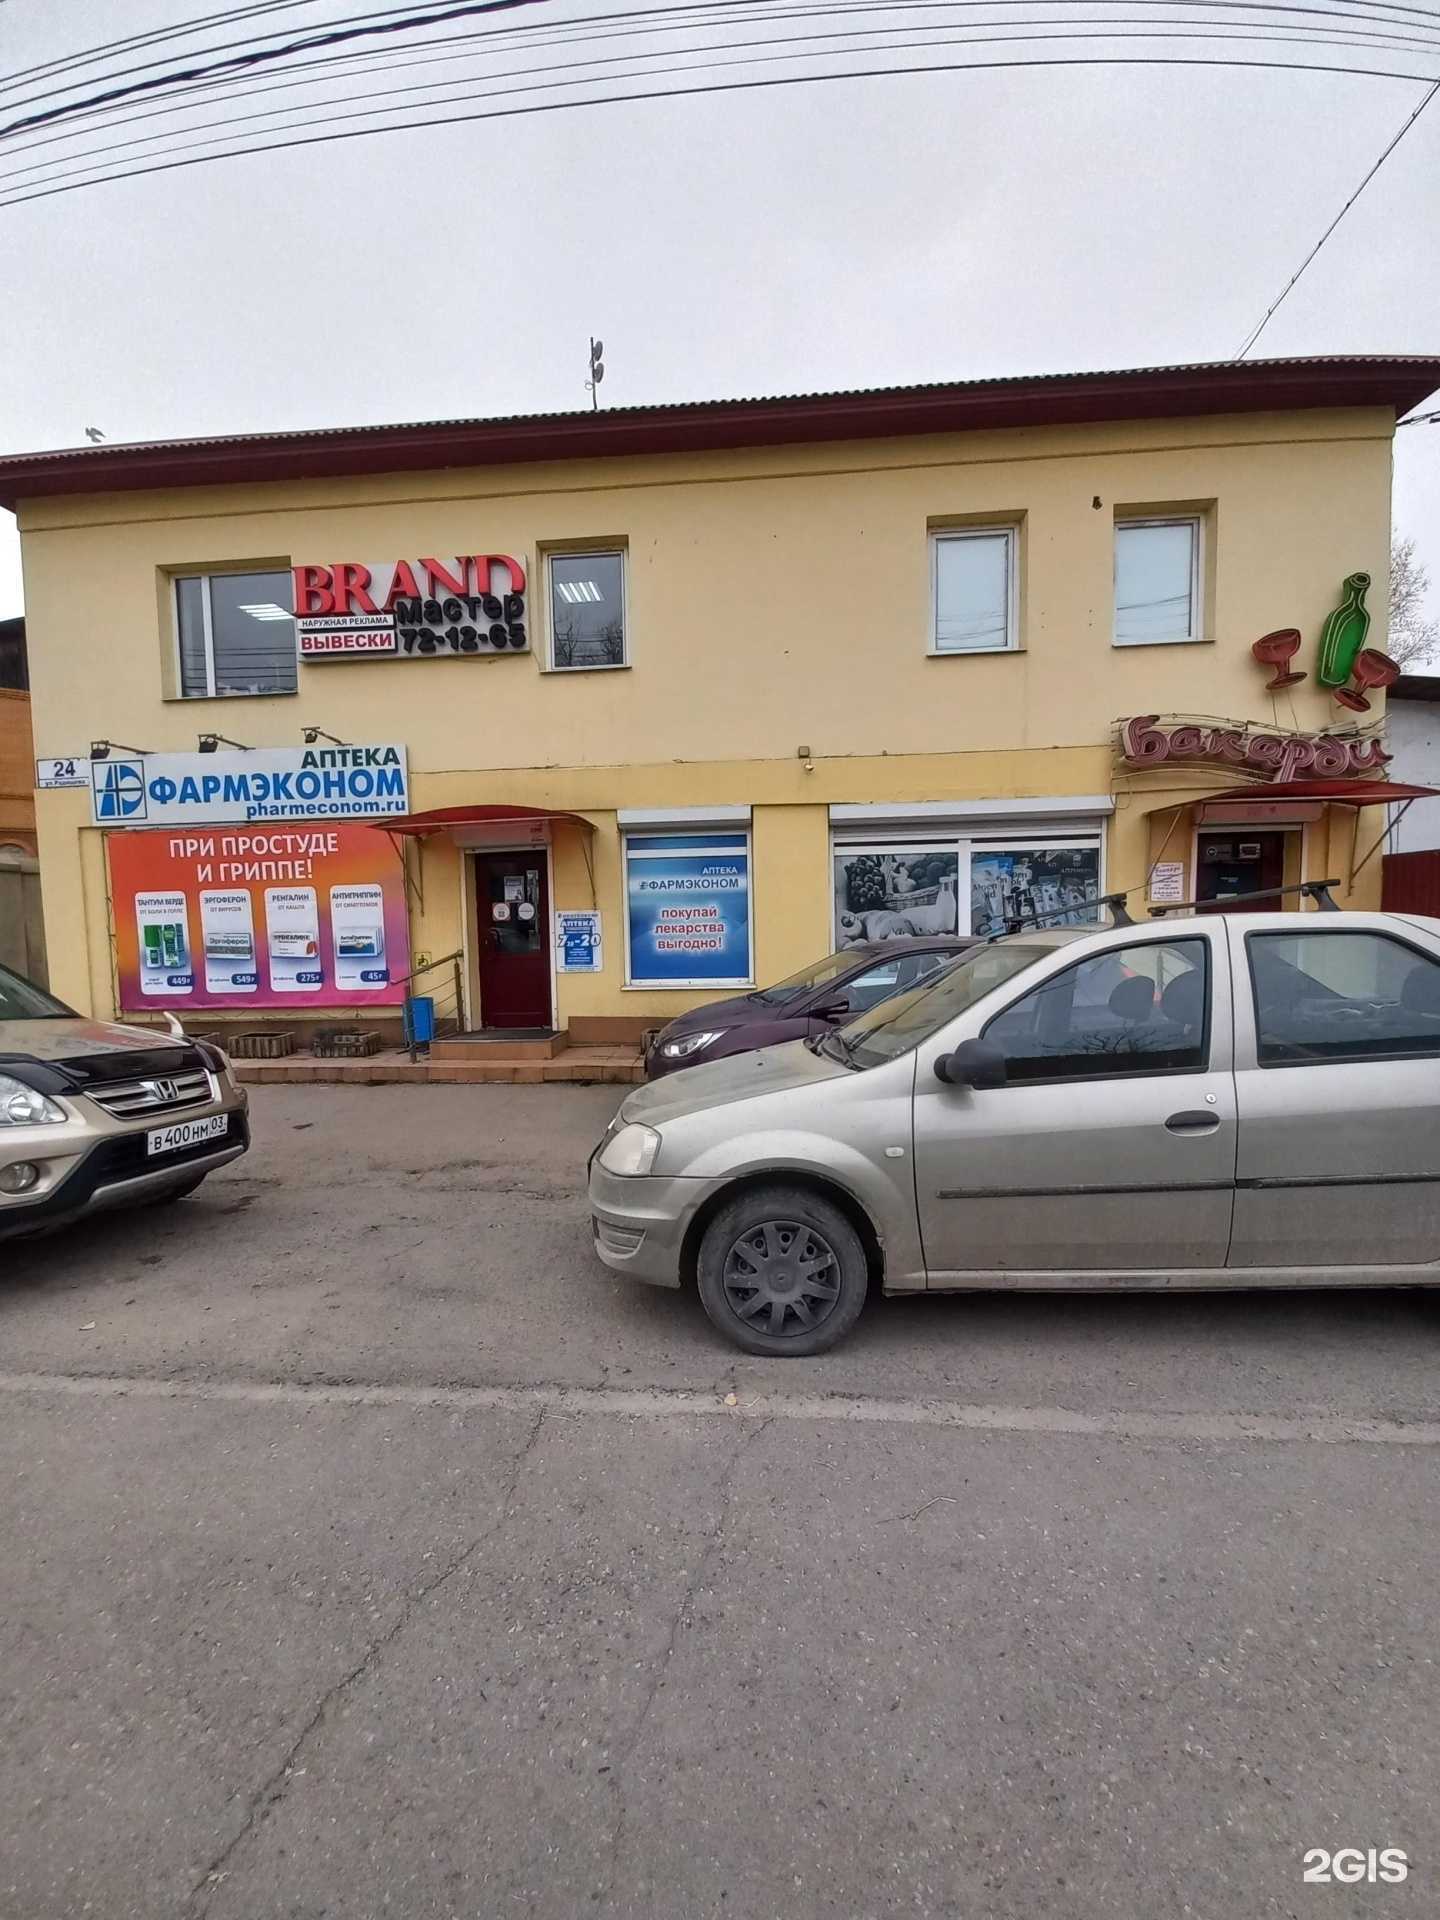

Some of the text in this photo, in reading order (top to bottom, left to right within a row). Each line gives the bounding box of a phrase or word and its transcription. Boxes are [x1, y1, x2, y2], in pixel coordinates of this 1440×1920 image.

[291, 553, 526, 615] BRAND
[302, 616, 389, 628] НАРУЖНАЯ РЕКЛАМА
[301, 632, 392, 650] ВЫВЕСКИ
[400, 622, 527, 652] 72-12-65
[301, 747, 401, 769] АПТЕКА
[54, 761, 76, 777] 24
[149, 768, 405, 805] ФАРМЭКОНОМ
[246, 798, 406, 818] pharmeconom.ru
[169, 832, 339, 858] ПРИ ПРОСТУДЕ
[197, 859, 313, 882] И ГРИППЕ!
[702, 866, 738, 875] АПТЕКА
[648, 878, 739, 890] ФАРМЭКОНОМ
[137, 898, 164, 907] ТАНТУМ
[204, 896, 247, 904] ЭРГОФЕРОН
[272, 894, 309, 902] РЕНГАЛИН
[661, 906, 717, 920] покупай
[655, 923, 724, 935] лекарства
[658, 937, 722, 949] выгодно!
[211, 1117, 224, 1130] 03
